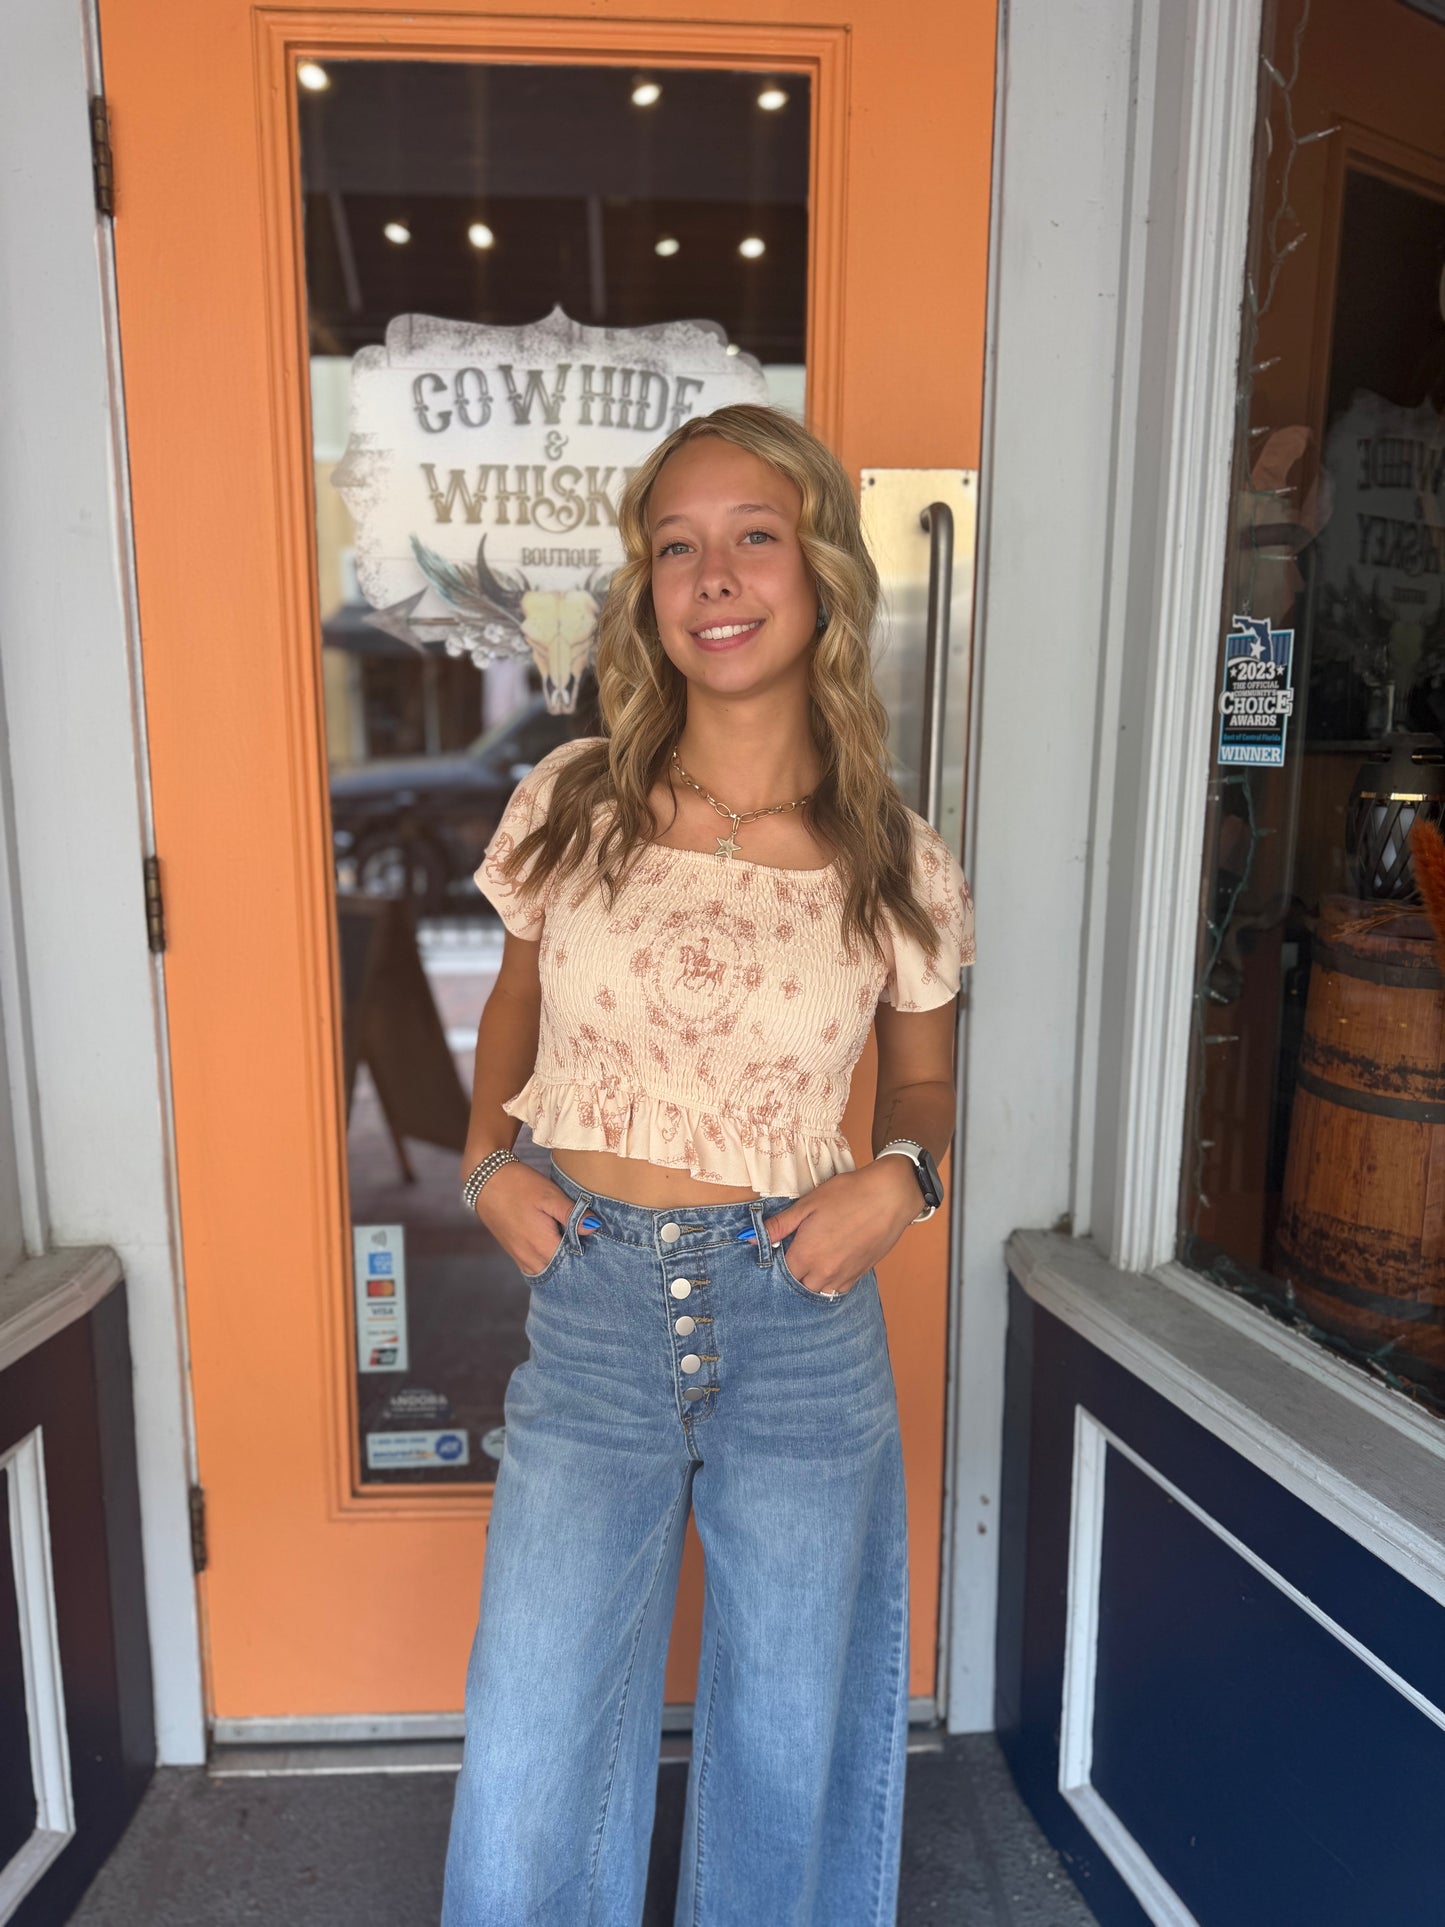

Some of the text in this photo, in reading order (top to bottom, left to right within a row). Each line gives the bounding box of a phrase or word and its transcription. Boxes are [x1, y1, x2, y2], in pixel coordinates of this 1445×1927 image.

[545, 430, 569, 461] &
[420, 463, 643, 534] WHISK
[522, 547, 601, 568] BOUTIQUE
[1237, 661, 1276, 681] 2023
[1232, 680, 1279, 690] THE OFFICIAL
[1220, 689, 1291, 715] CHOICE
[1229, 715, 1277, 726] AWARDS
[1220, 746, 1281, 762] WINNER
